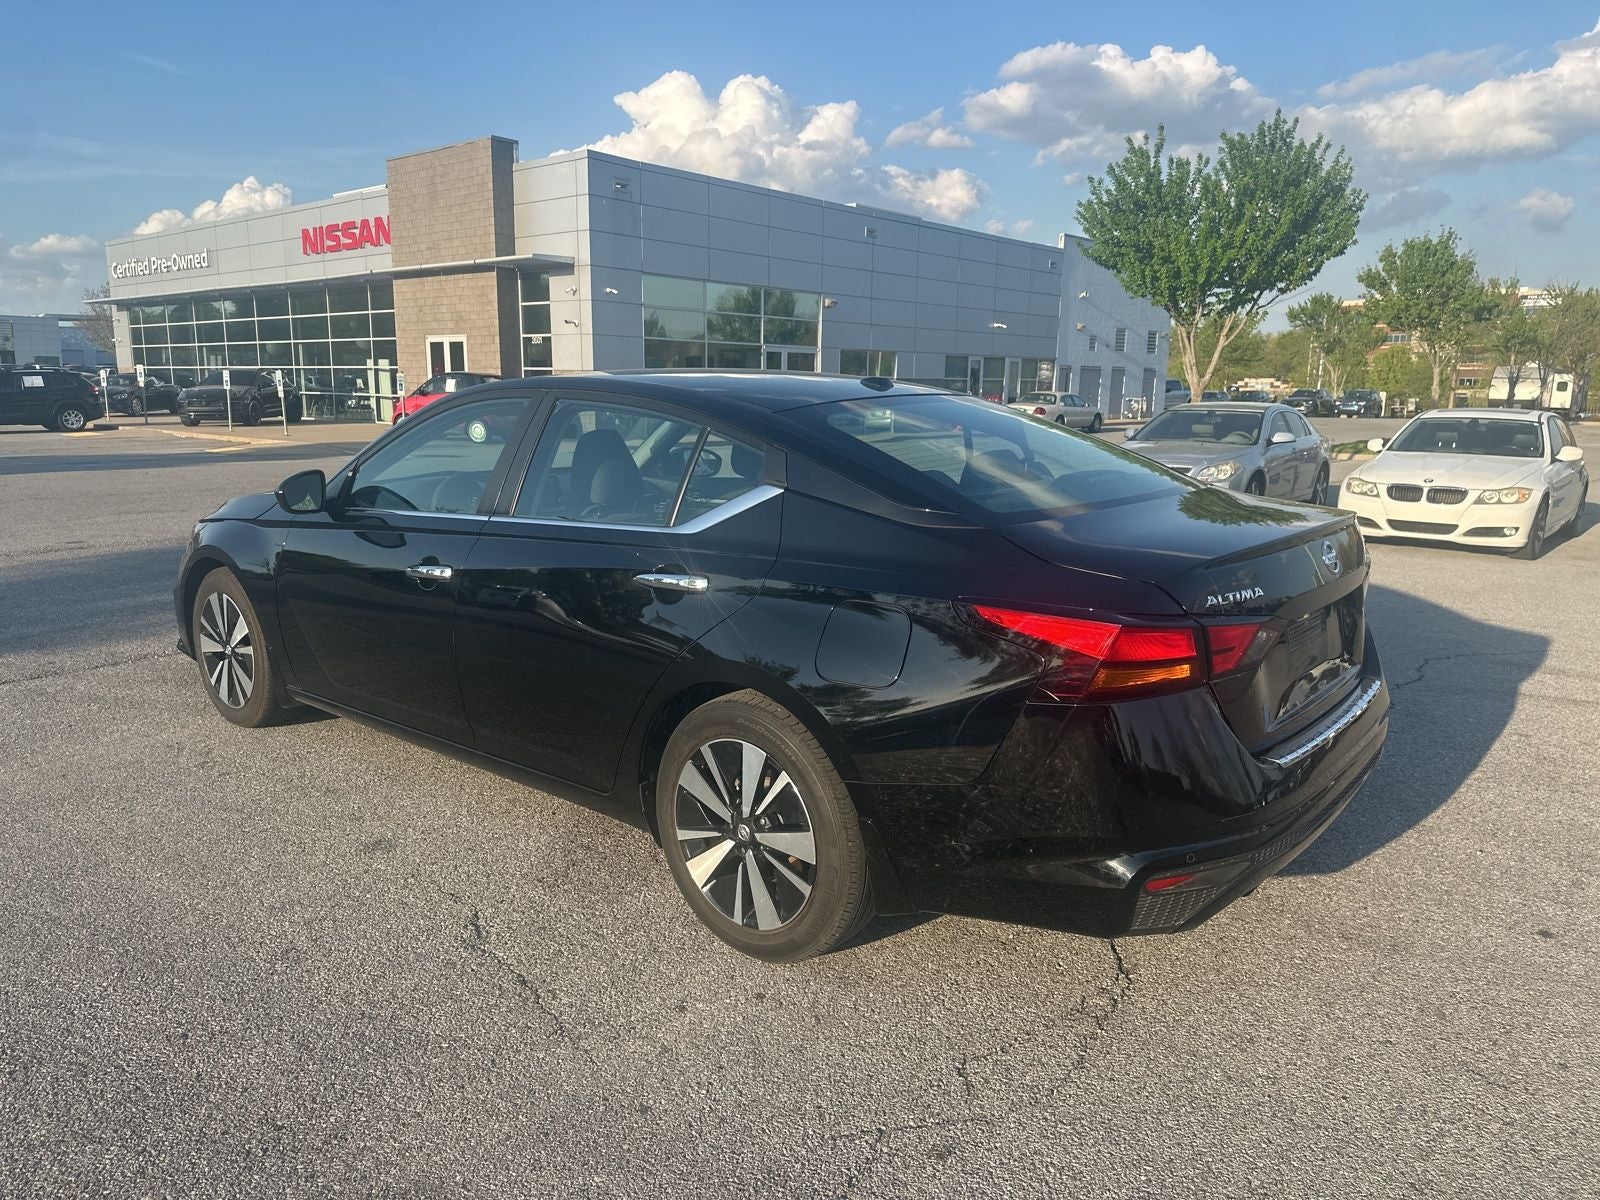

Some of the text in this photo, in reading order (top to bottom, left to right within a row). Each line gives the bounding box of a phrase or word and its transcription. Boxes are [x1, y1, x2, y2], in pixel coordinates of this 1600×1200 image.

[301, 215, 391, 255] NISSAN
[111, 248, 208, 279] Certified Pre-Owned
[1205, 587, 1265, 608] ALTIMA
